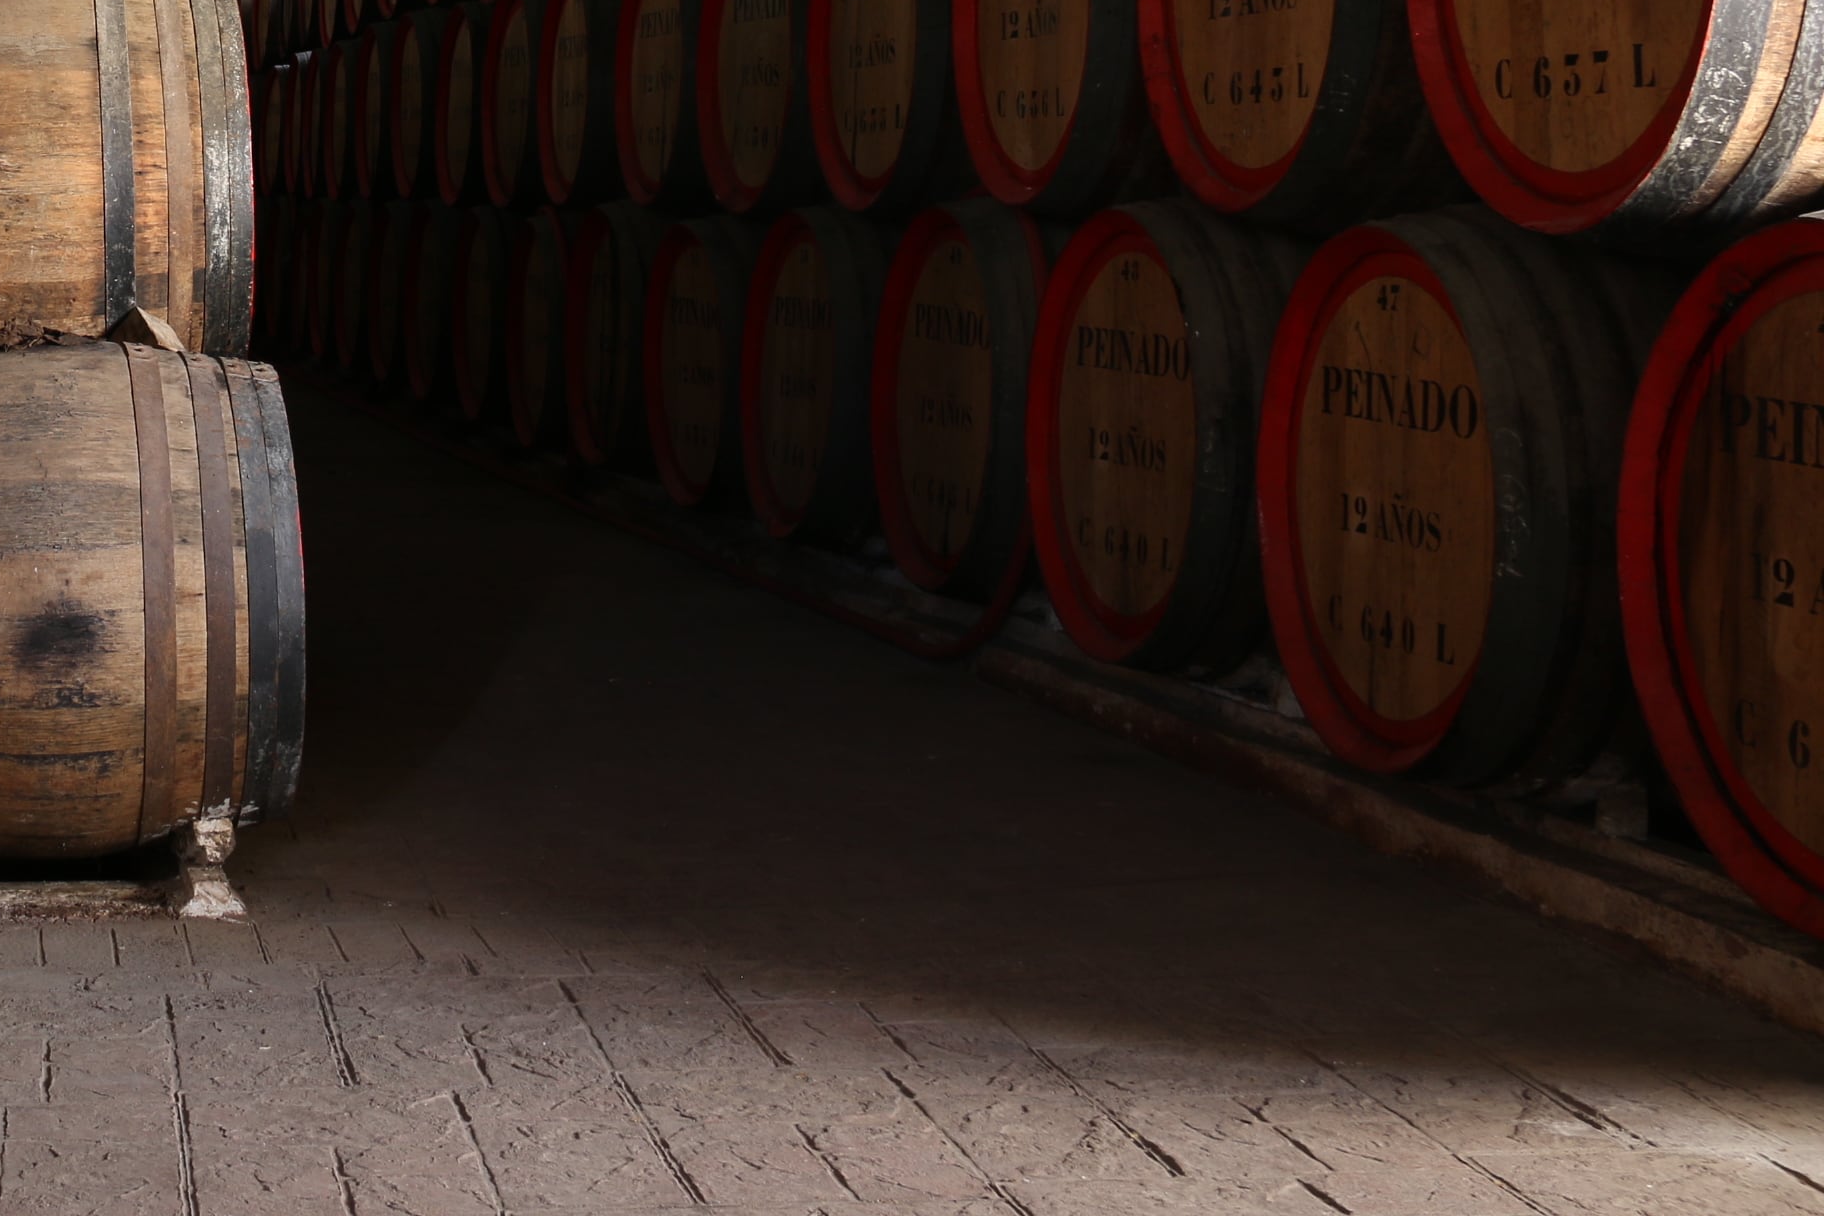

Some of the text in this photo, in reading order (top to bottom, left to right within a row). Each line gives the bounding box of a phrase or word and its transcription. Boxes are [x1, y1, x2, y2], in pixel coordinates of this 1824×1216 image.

[1001, 0, 1060, 40] 12 AÑOS
[865, 33, 895, 68] AÑOS
[1495, 58, 1512, 100] C
[1632, 43, 1657, 88] L
[997, 90, 1006, 117] C
[1056, 87, 1065, 117] L
[1203, 72, 1215, 105] C
[1297, 63, 1309, 98] L
[1377, 284, 1400, 311] 47
[915, 303, 990, 349] PEINADO
[1078, 325, 1190, 381] PEINADO
[1322, 365, 1477, 439] PEINADO
[1088, 424, 1166, 472] 12 AÑOS
[1340, 492, 1442, 552] 12 AÑOS
[1162, 536, 1172, 571] L
[1751, 552, 1795, 608] 12
[1329, 594, 1455, 665] C 640 L
